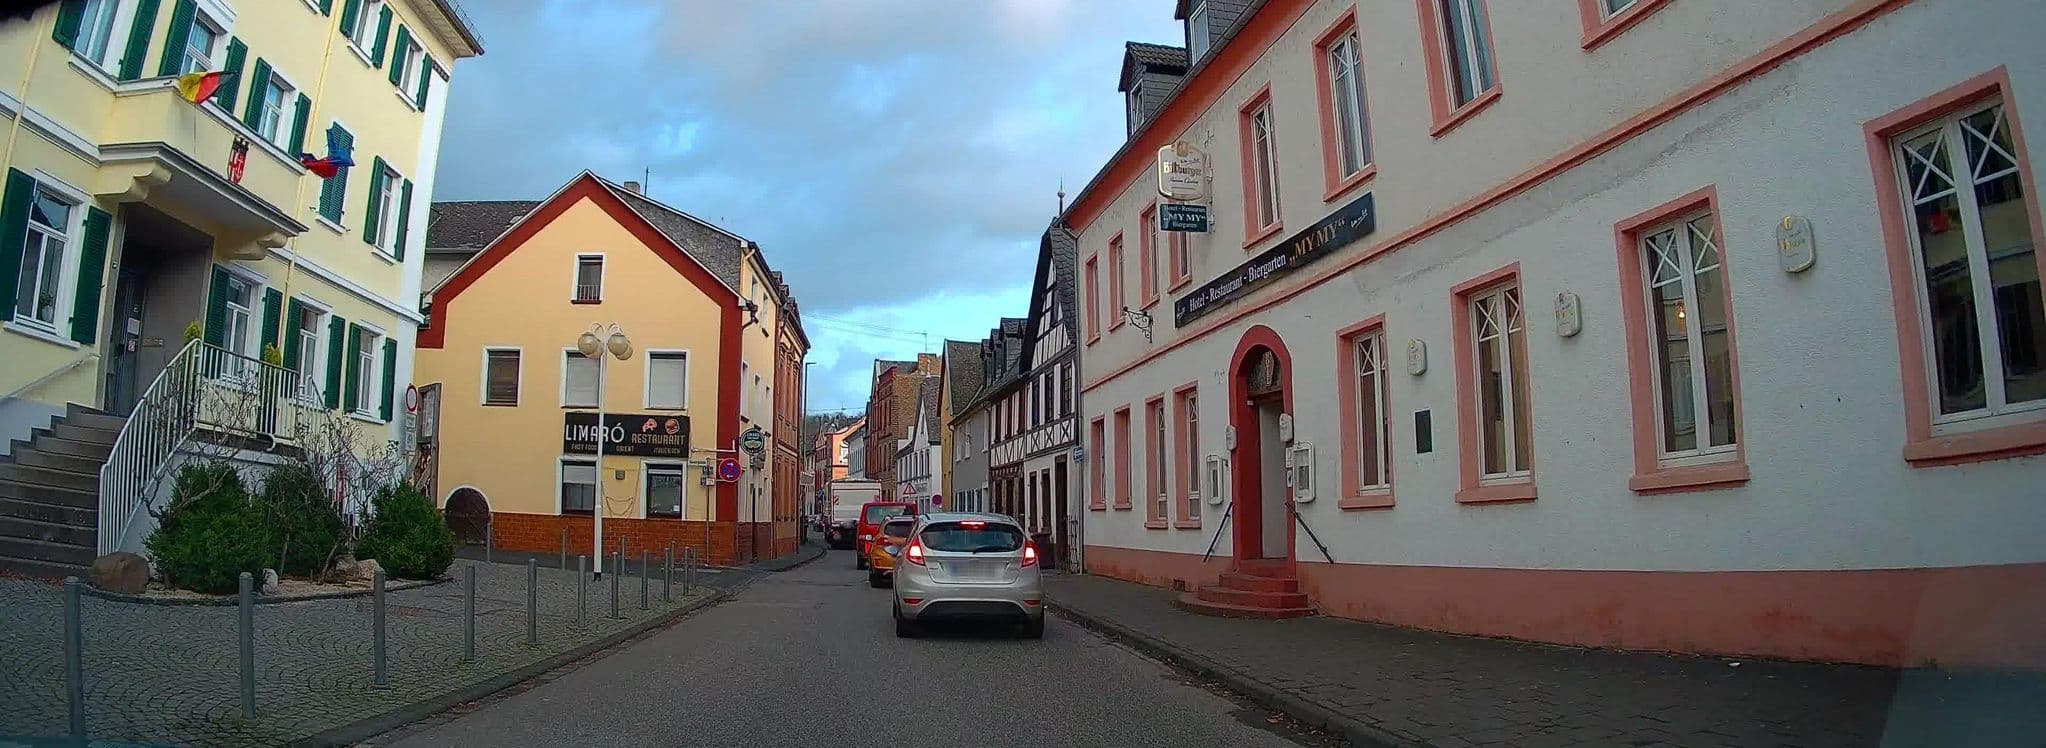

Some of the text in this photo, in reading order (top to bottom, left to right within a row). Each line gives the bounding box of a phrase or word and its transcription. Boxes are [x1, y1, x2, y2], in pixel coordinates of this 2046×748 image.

[1189, 292, 1206, 313] Hotel
[1209, 275, 1243, 302] Restaurant
[1248, 253, 1287, 282] Biergarten
[565, 422, 625, 443] LIMARÓ
[631, 433, 686, 446] RESTAURANT
